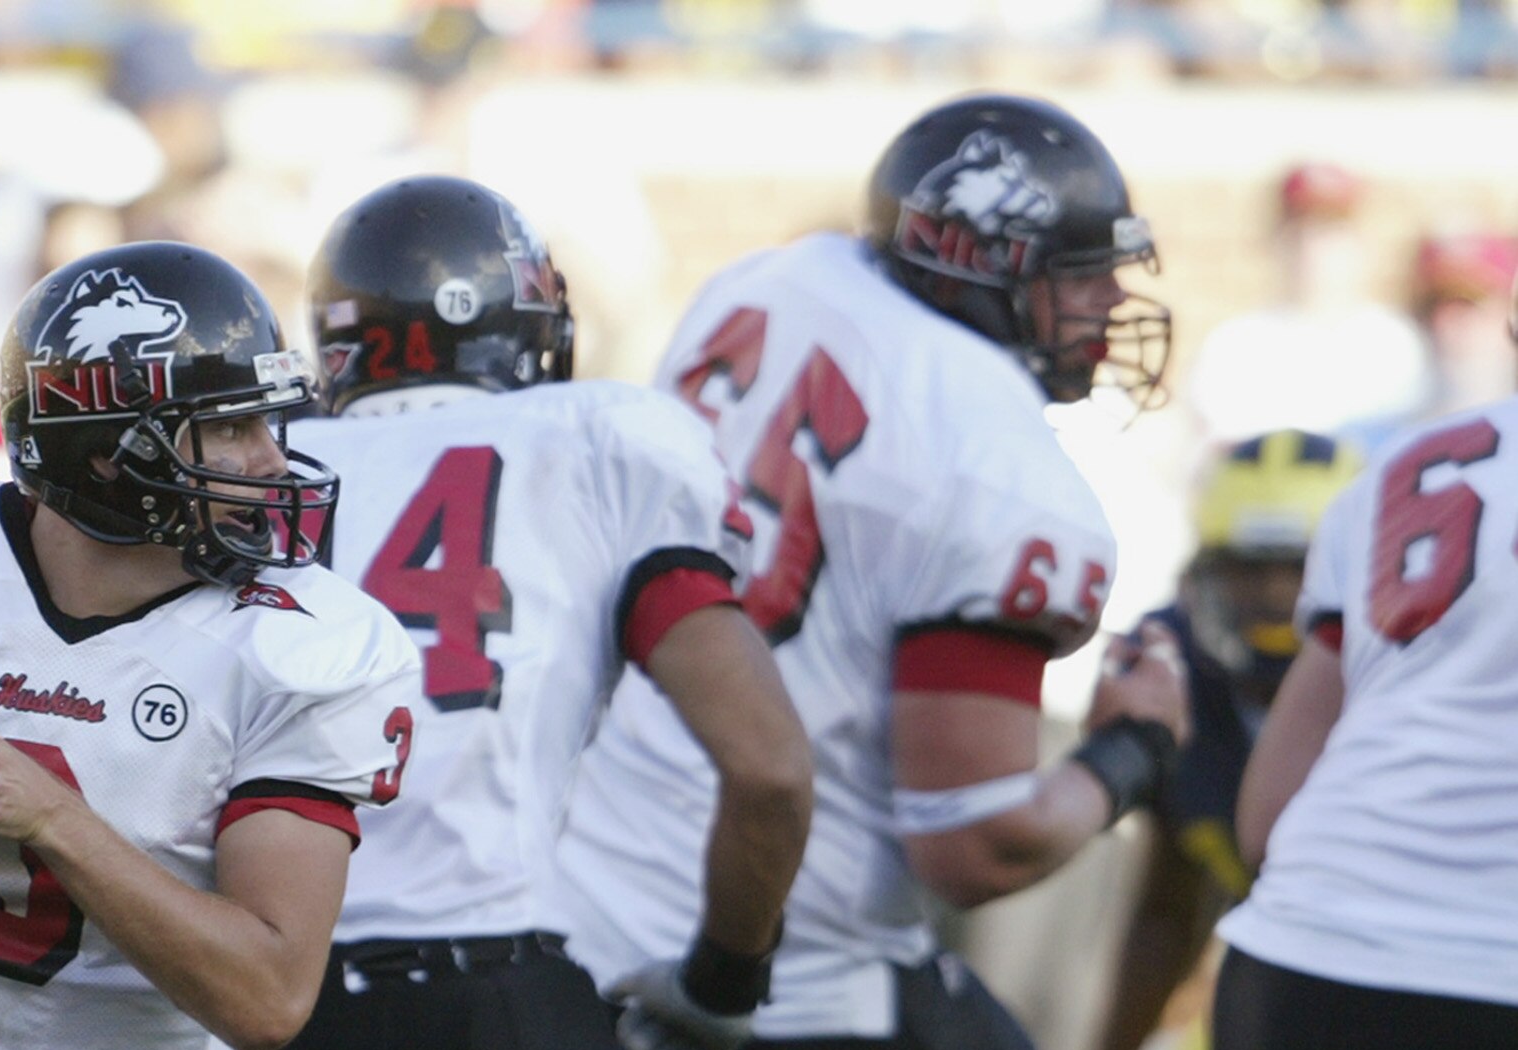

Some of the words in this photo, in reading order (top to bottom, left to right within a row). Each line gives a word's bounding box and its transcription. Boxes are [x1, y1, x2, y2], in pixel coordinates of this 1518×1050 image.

[900, 210, 1028, 276] NIU
[443, 290, 473, 315] 76
[362, 320, 436, 381] 24
[35, 362, 165, 415] NIU
[1368, 417, 1518, 649] 6
[143, 700, 178, 726] 76
[369, 705, 413, 806] 3
